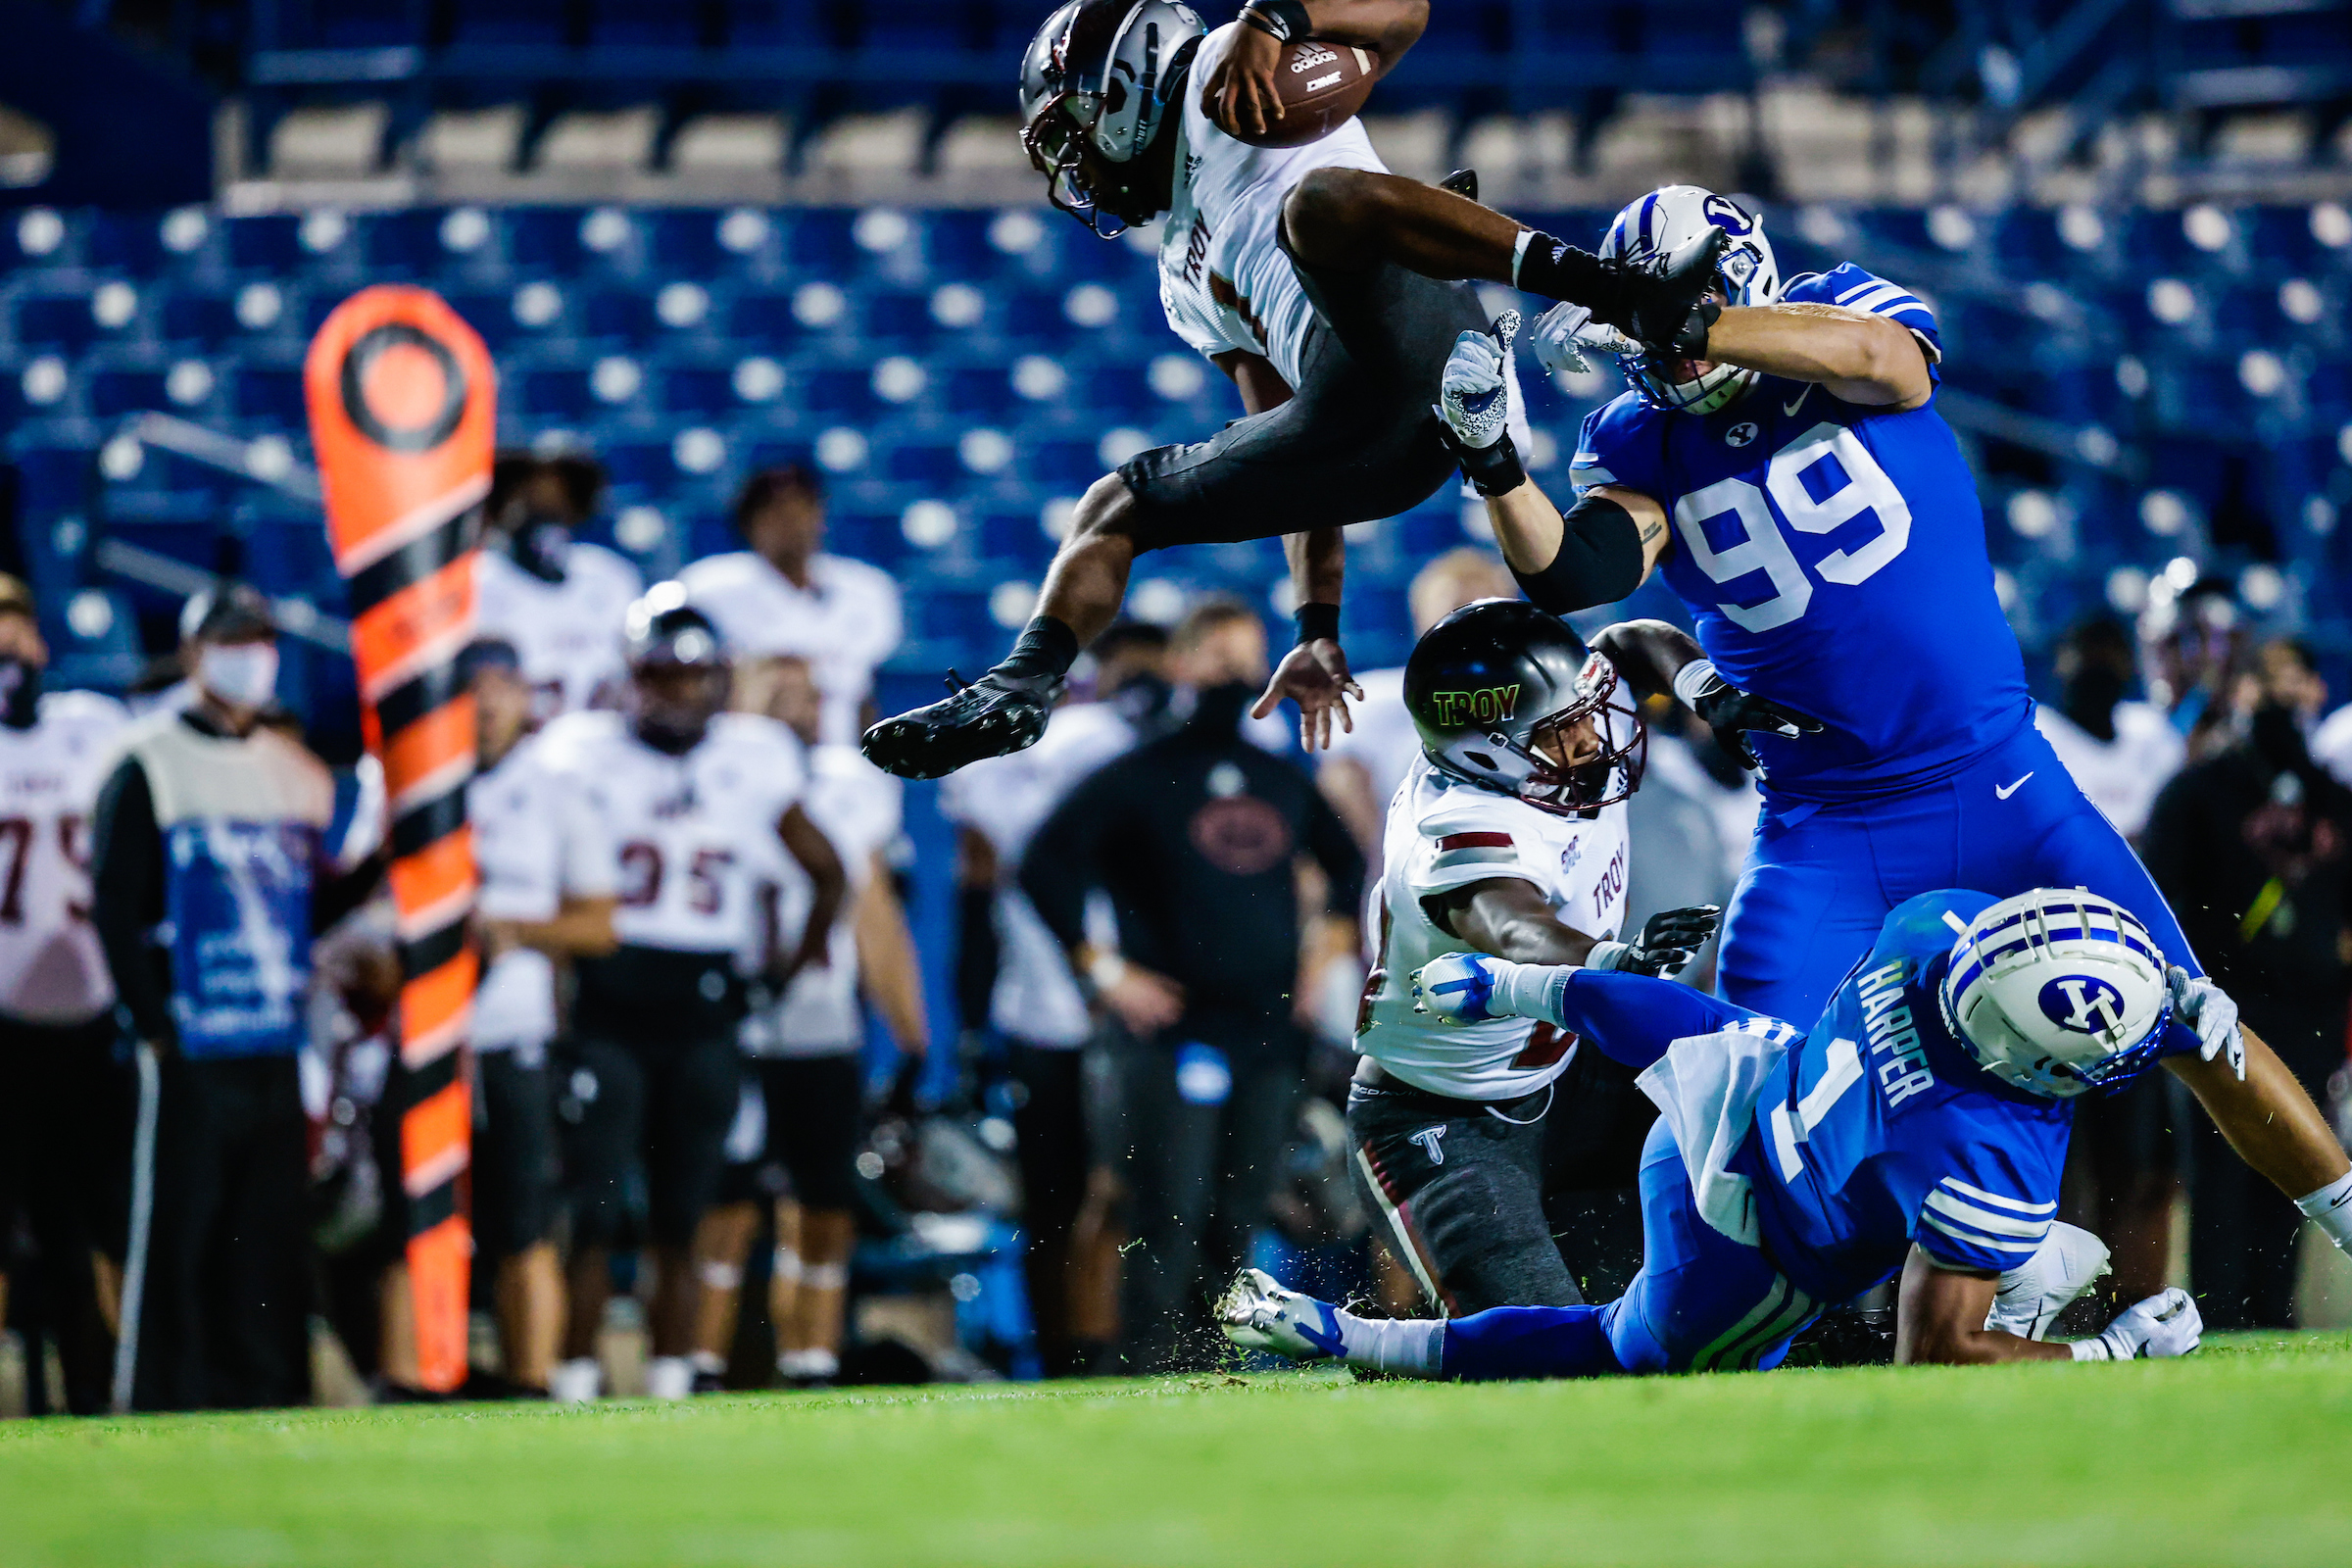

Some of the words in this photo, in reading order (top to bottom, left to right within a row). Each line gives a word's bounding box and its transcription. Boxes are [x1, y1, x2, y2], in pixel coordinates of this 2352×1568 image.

[1290, 50, 1339, 74] adidas
[1183, 208, 1212, 294] TROY
[1674, 420, 1913, 634] 99
[1433, 683, 1521, 726] TROY
[1592, 841, 1625, 920] TROY
[1856, 959, 1936, 1109] HARPER
[1770, 1037, 1865, 1185] 1
